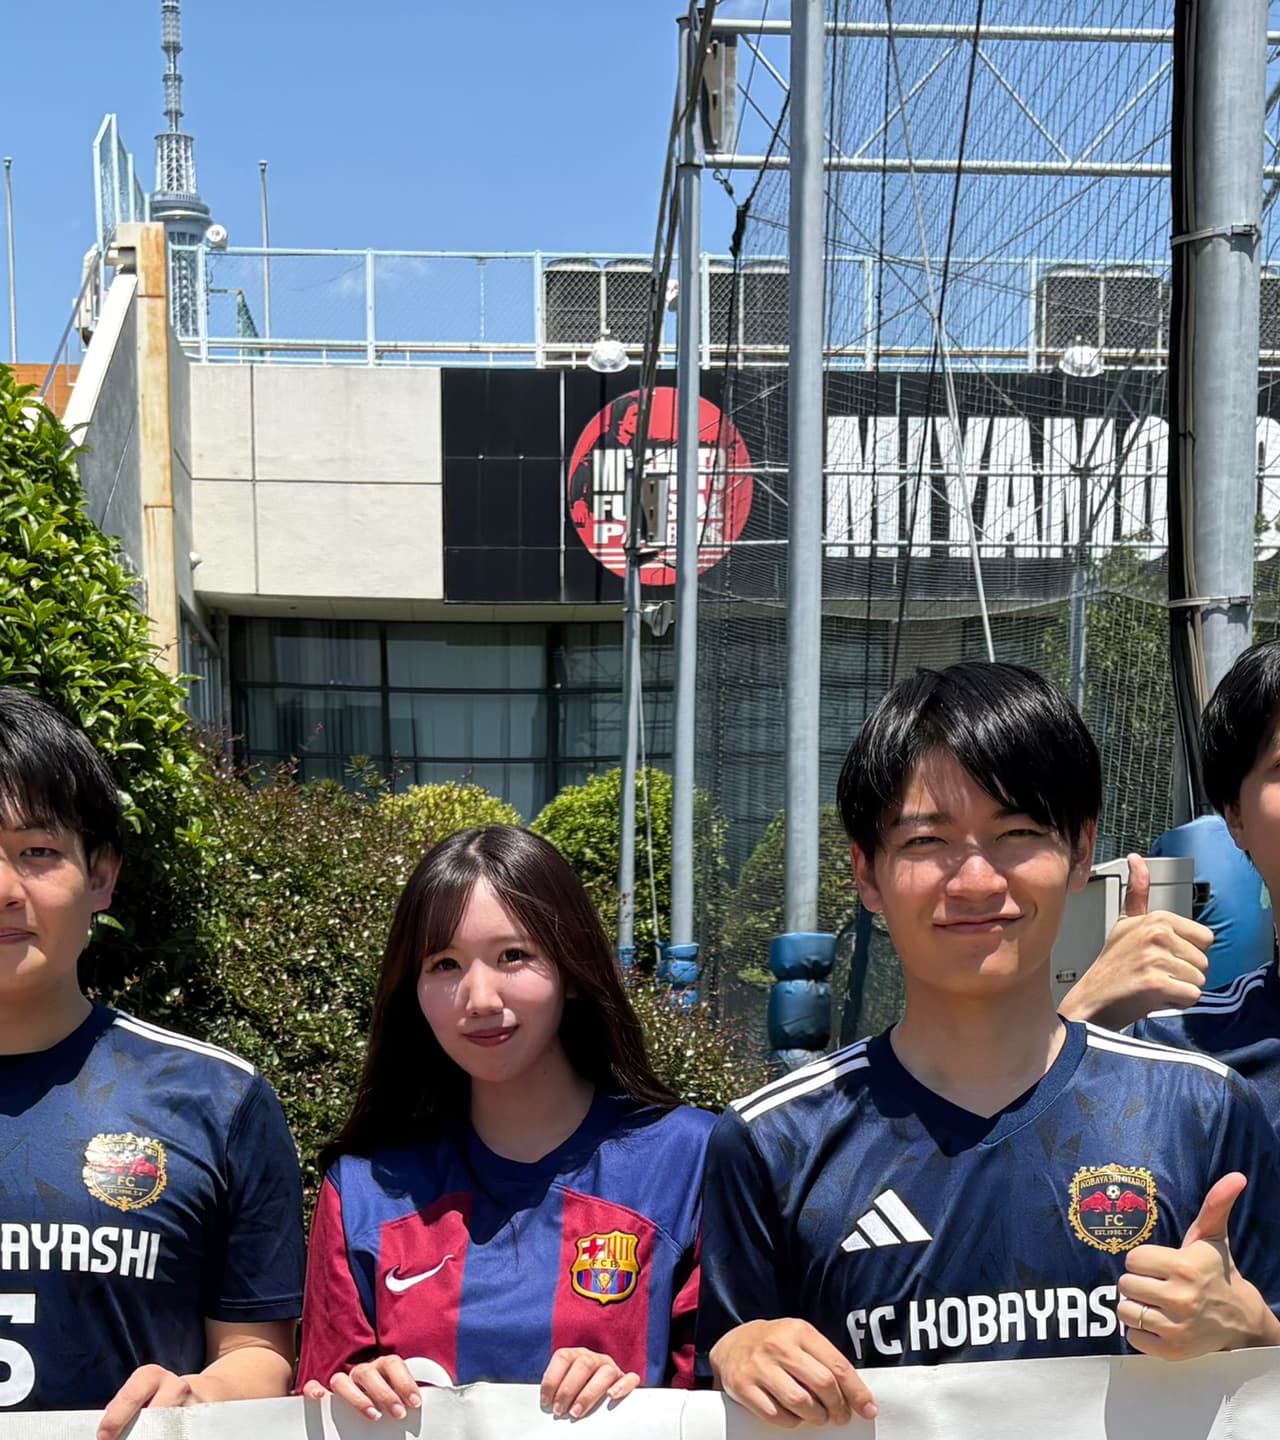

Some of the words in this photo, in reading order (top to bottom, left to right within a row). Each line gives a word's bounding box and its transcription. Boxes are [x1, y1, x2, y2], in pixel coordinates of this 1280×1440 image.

[1104, 1214, 1124, 1226] FC
[846, 1304, 903, 1360] FC
[909, 1285, 1125, 1351] KOBAYAS
